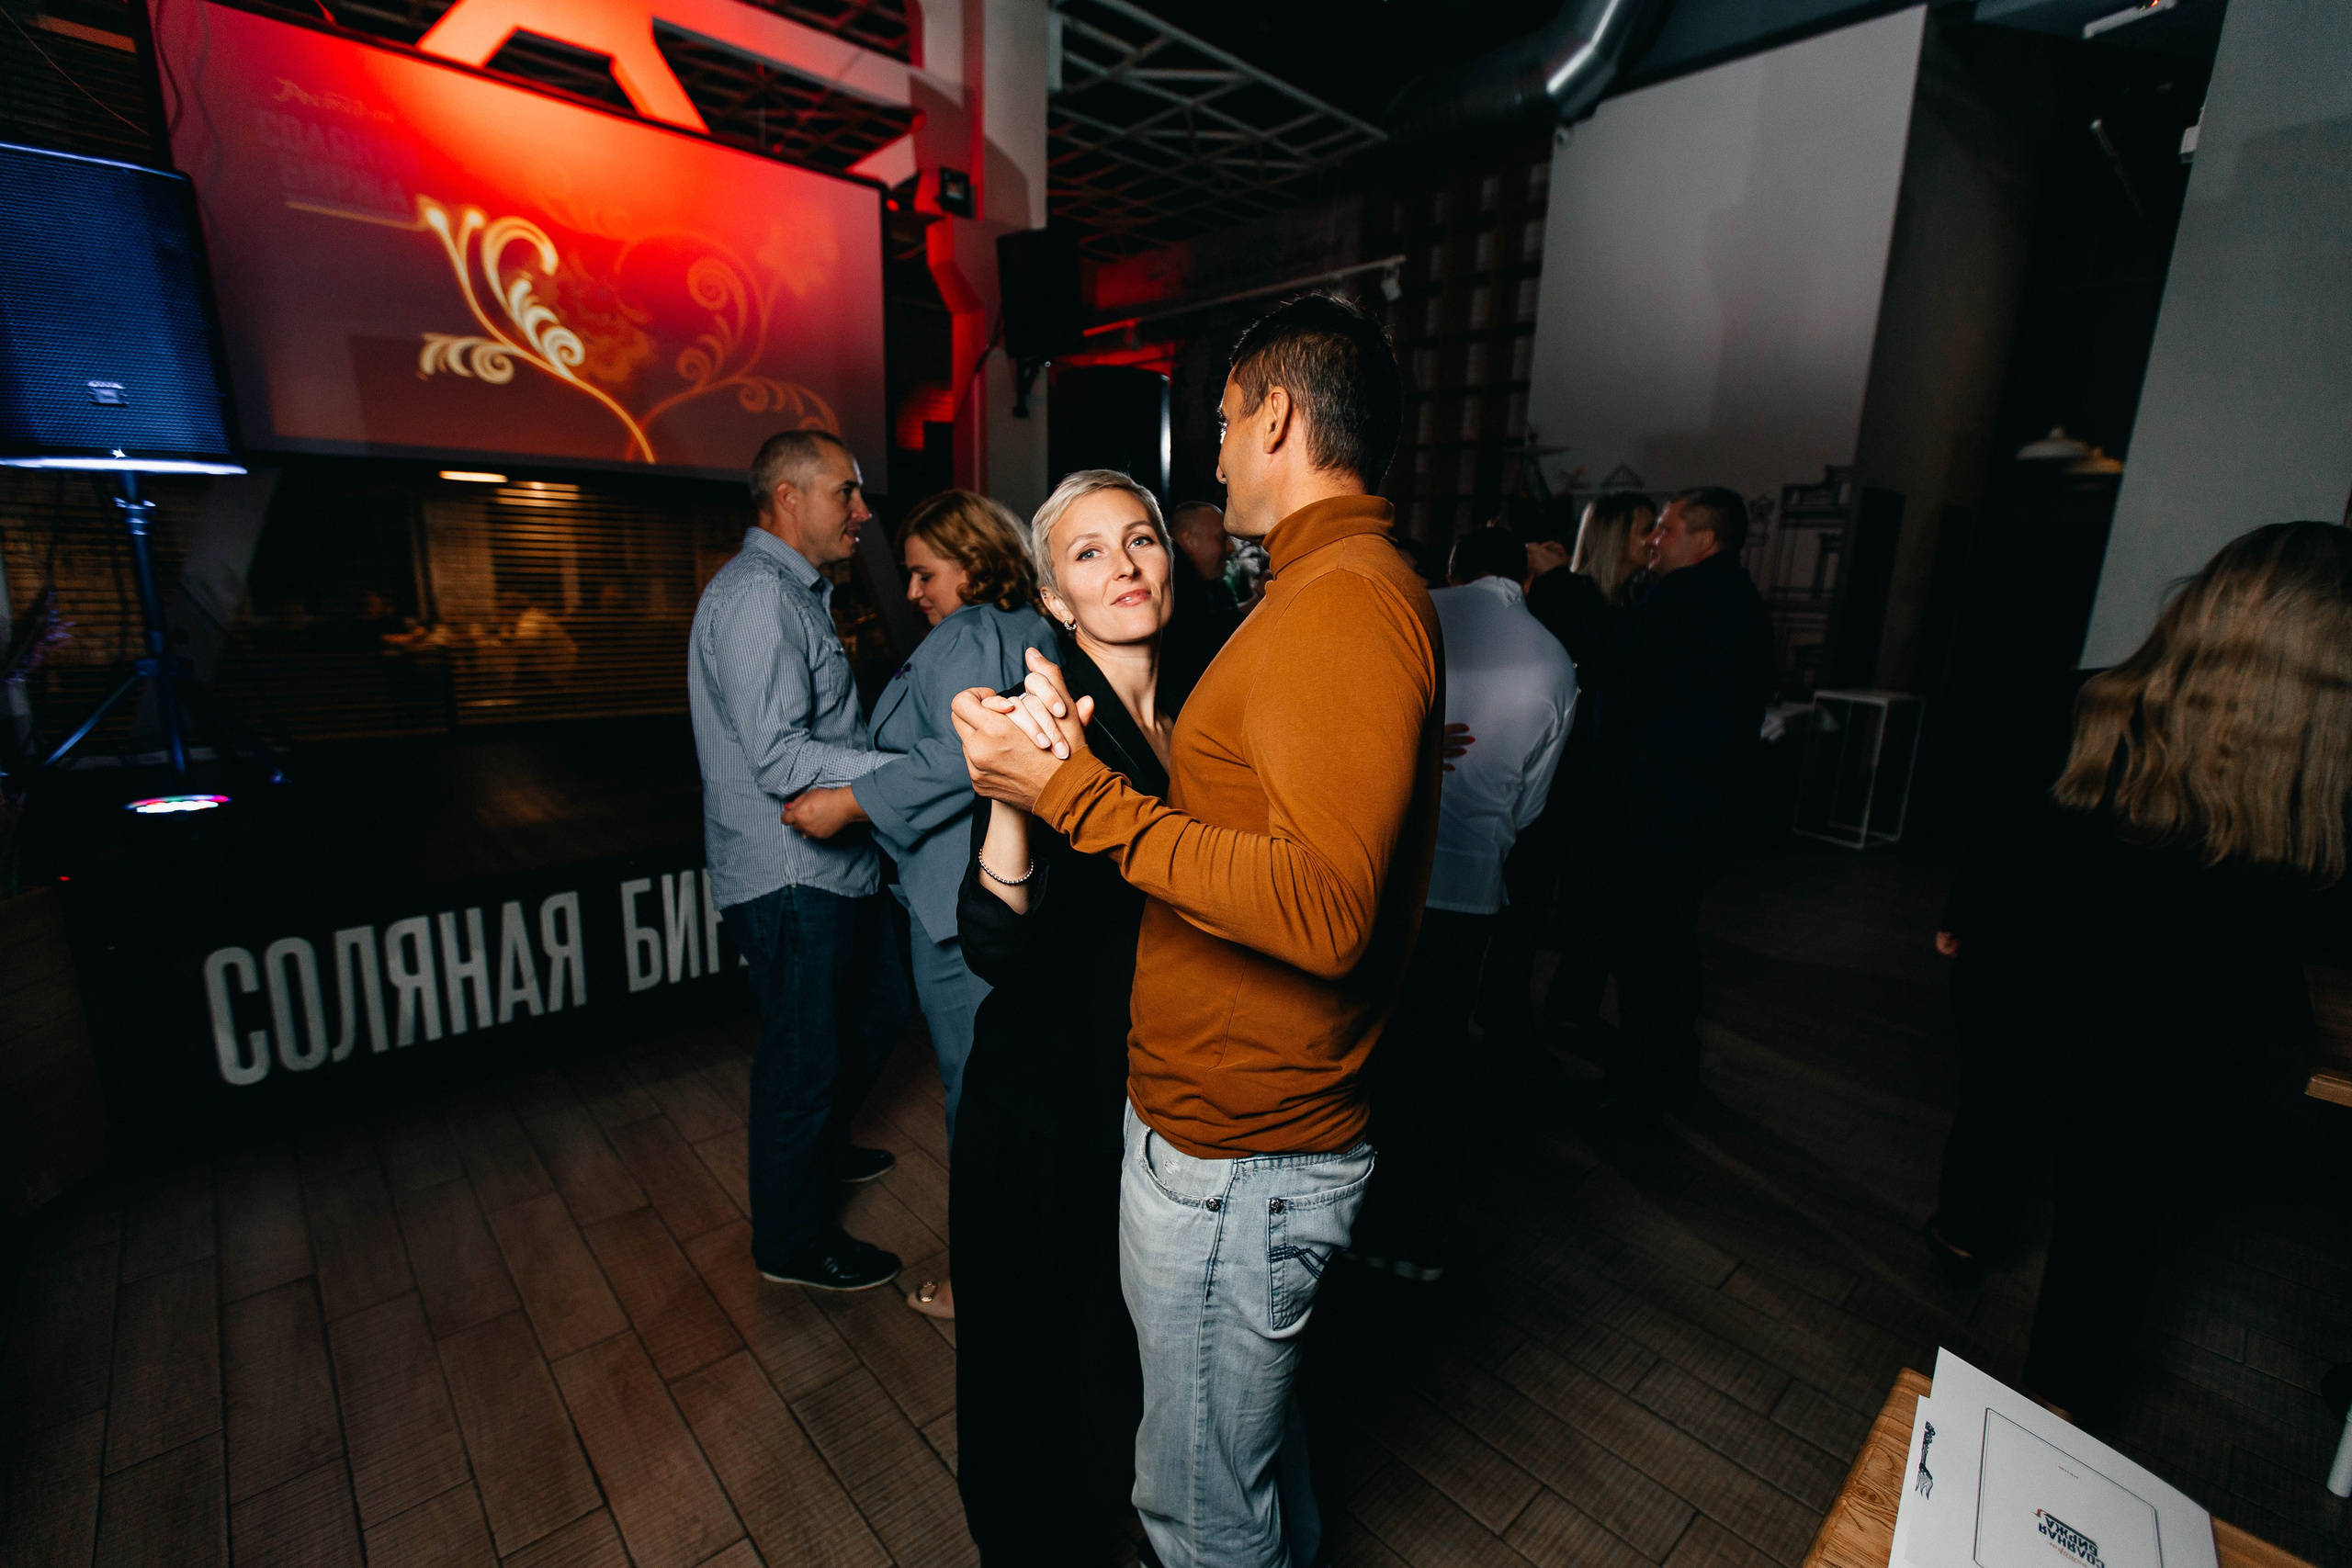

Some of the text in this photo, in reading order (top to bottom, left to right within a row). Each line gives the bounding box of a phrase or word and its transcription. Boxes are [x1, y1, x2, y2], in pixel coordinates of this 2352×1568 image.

[203, 890, 587, 1086] СОЛЯНАЯ
[2038, 1522, 2105, 1568] СОЛЯНАЯ
[2044, 1516, 2098, 1557] БИРЖА
